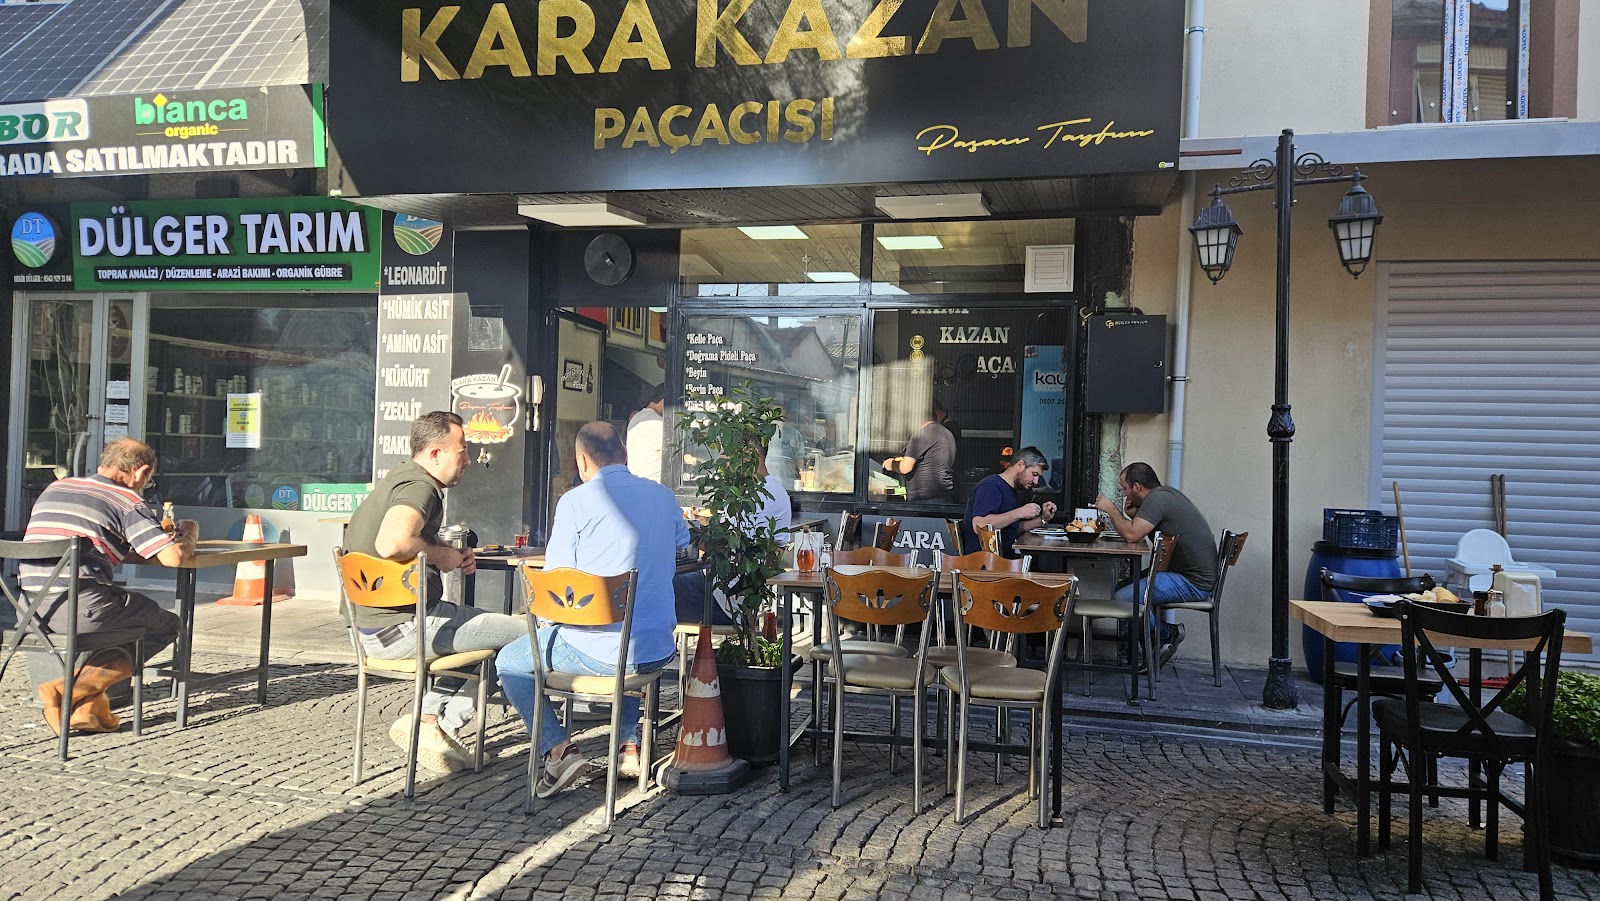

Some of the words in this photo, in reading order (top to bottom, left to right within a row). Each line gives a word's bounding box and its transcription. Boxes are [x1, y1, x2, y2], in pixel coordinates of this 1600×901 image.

[401, 0, 671, 82] KARA
[695, 0, 1088, 68] KAZAN
[135, 93, 248, 125] bianca
[164, 122, 218, 139] organic
[594, 97, 834, 154] PAÇACISI
[66, 140, 298, 173] SATILMAKTADIR
[21, 218, 43, 234] DT
[79, 205, 230, 257] DÜLGER
[240, 211, 365, 254] TARIM
[98, 269, 129, 279] TOPRAK
[129, 267, 158, 279] ANALİZİ
[166, 267, 212, 278] DÜZENLEME
[217, 266, 241, 278] ARAZİ
[242, 268, 270, 278] BAKIMI
[276, 265, 313, 278] ORGANİK
[314, 266, 343, 278] GÜBRE
[424, 296, 449, 319] ASİT
[422, 330, 448, 353] ASİT
[707, 334, 723, 346] Paça
[940, 327, 1010, 344] KAZAN
[740, 351, 756, 364] Paça
[977, 356, 1017, 378] AÇA
[453, 377, 472, 386] KARA
[279, 490, 292, 499] DT
[303, 489, 352, 511] DÜLGER
[893, 530, 945, 549] ARA
